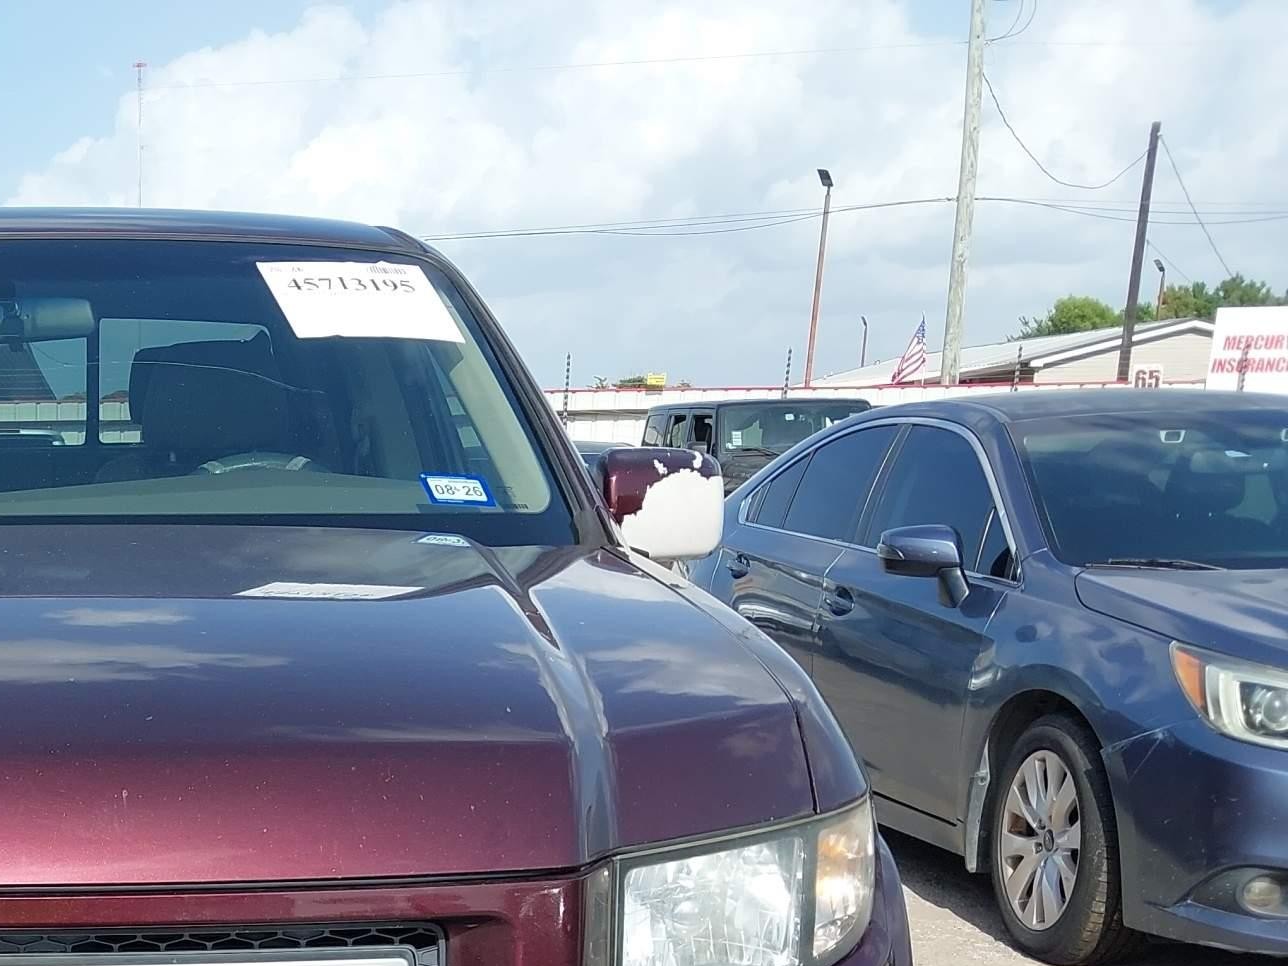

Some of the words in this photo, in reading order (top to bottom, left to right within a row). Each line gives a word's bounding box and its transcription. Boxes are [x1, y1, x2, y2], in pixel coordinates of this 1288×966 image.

[287, 276, 417, 294] 45713195
[1210, 356, 1288, 374] INSURANC
[1134, 369, 1161, 389] 65
